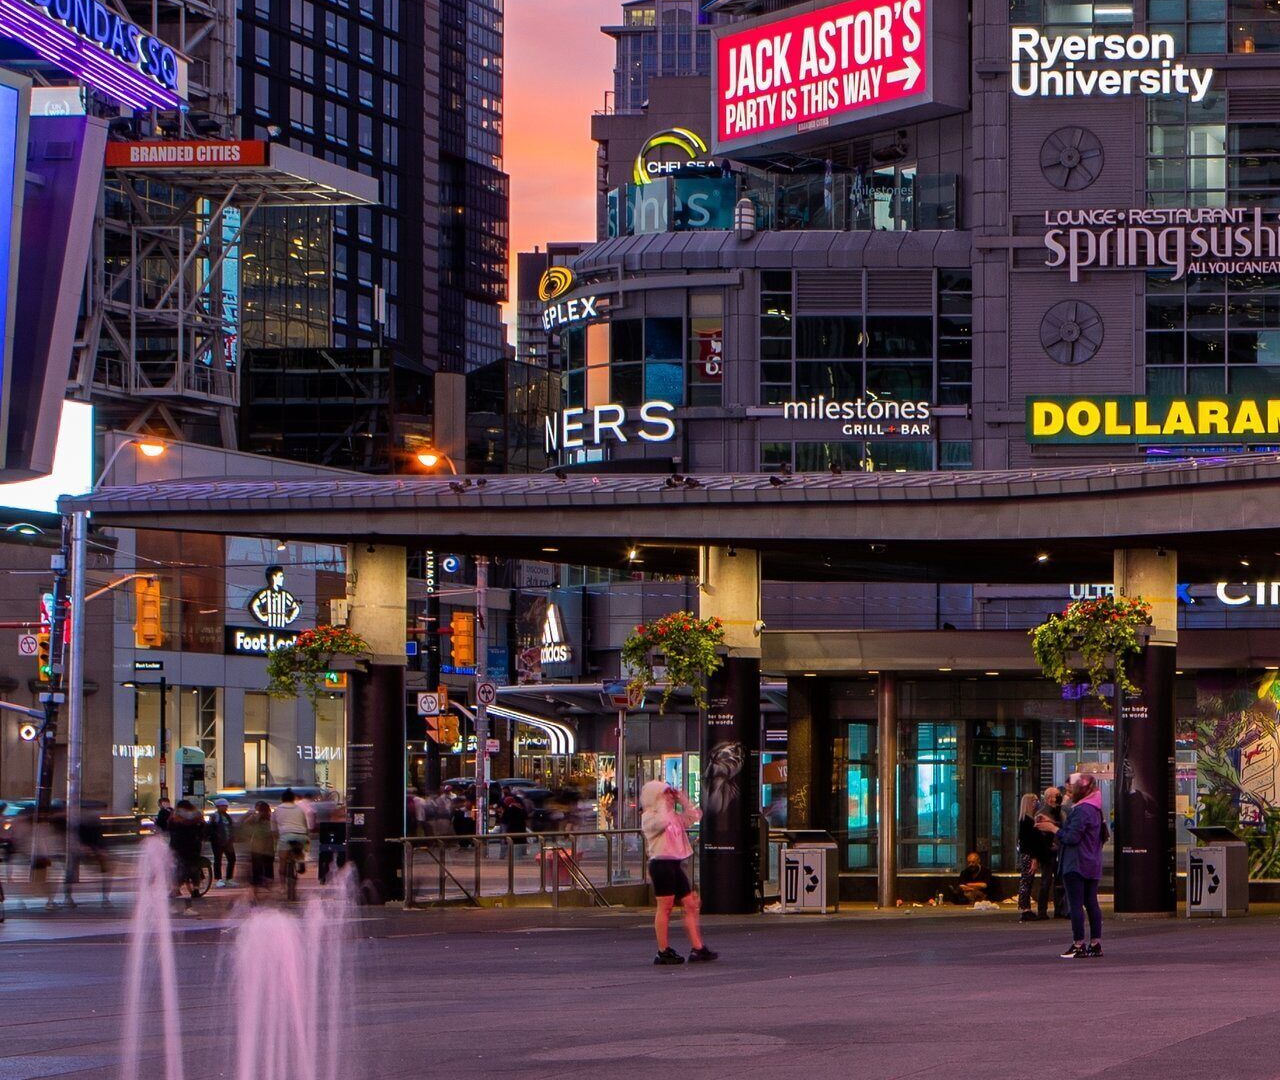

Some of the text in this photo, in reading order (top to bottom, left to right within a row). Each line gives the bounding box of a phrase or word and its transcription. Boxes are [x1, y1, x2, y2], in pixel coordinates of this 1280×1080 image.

[146, 37, 179, 91] SQ
[1011, 27, 1175, 69] Ryerson
[724, 32, 793, 101] JACK
[1011, 60, 1214, 102] University
[724, 65, 884, 136] PARTY IS THIS WAY
[129, 145, 241, 164] BRANDED CITIES
[1044, 207, 1248, 226] LOUNGE RESTAURANT
[783, 394, 931, 420] milestones
[842, 424, 885, 435] GRILL
[900, 424, 931, 435] BAR
[235, 631, 267, 651] Foot
